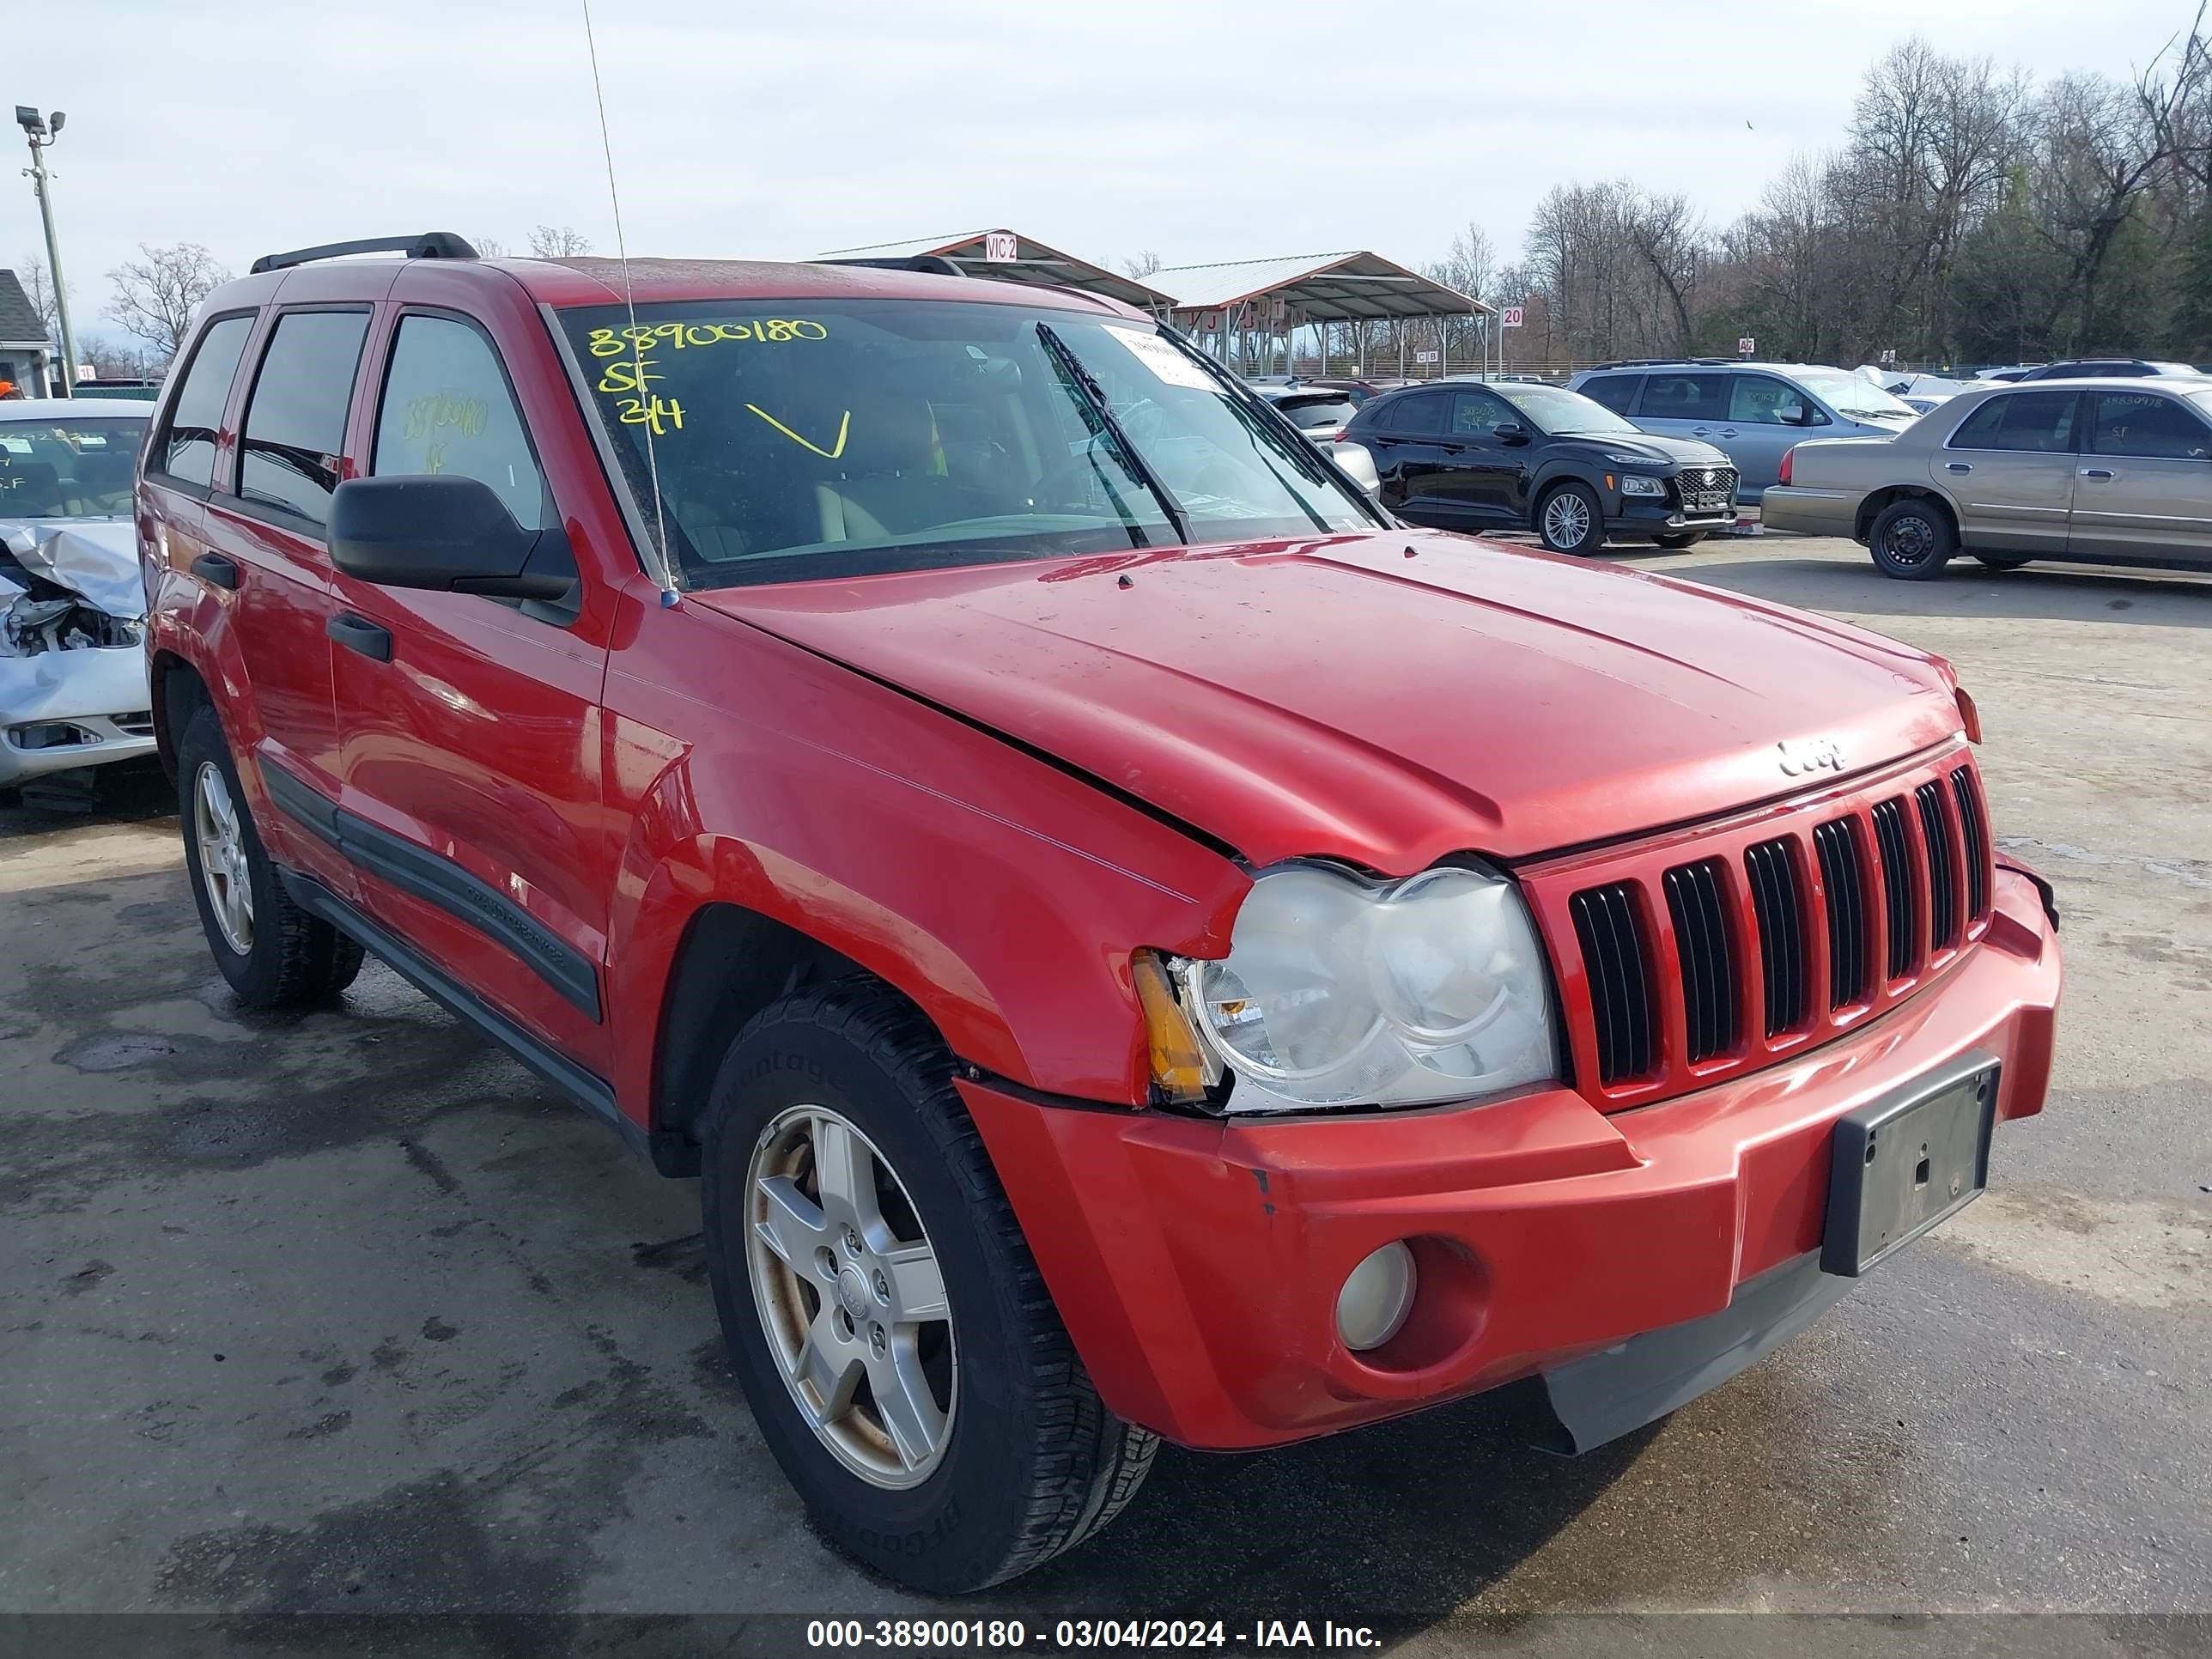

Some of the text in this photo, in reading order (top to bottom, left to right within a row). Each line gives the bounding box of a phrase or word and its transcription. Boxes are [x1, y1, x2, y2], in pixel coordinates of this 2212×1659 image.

[988, 238, 1016, 258] VIC 2
[1207, 315, 1216, 330] J
[1504, 309, 1521, 324] 20
[586, 319, 828, 357] 38900180
[1419, 353, 1425, 362] C
[1430, 352, 1437, 361] B
